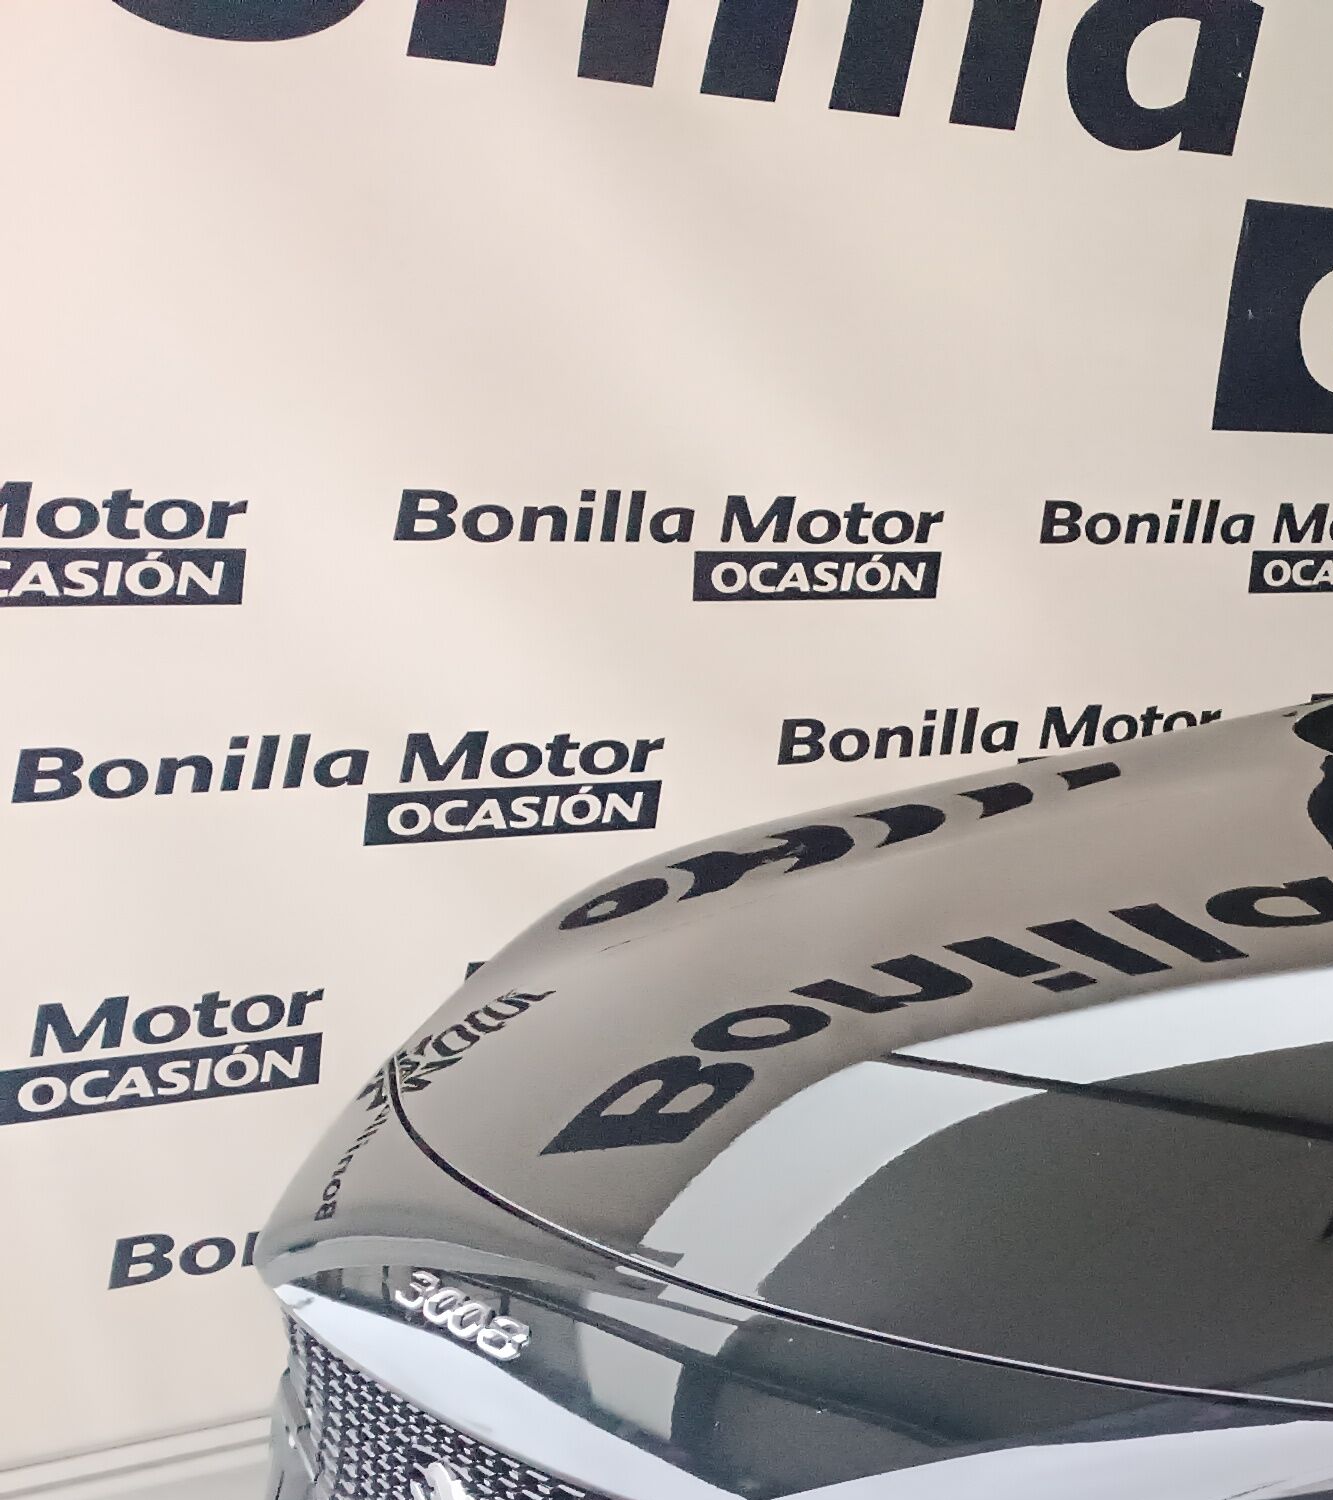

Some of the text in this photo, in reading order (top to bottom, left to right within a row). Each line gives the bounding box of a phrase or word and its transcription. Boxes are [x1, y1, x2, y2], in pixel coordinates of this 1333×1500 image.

[393, 489, 945, 547] Bonilla Motor
[1039, 501, 1253, 548] Bonilla
[711, 553, 926, 594] OCASIÓN
[14, 730, 664, 802] Bonilla Motor
[777, 704, 1222, 766] Bonilla Motor
[387, 786, 644, 838] OCASIÓN
[31, 989, 325, 1056] Motor
[18, 1046, 303, 1112] OCASIÓN
[395, 1271, 531, 1361] 3008
